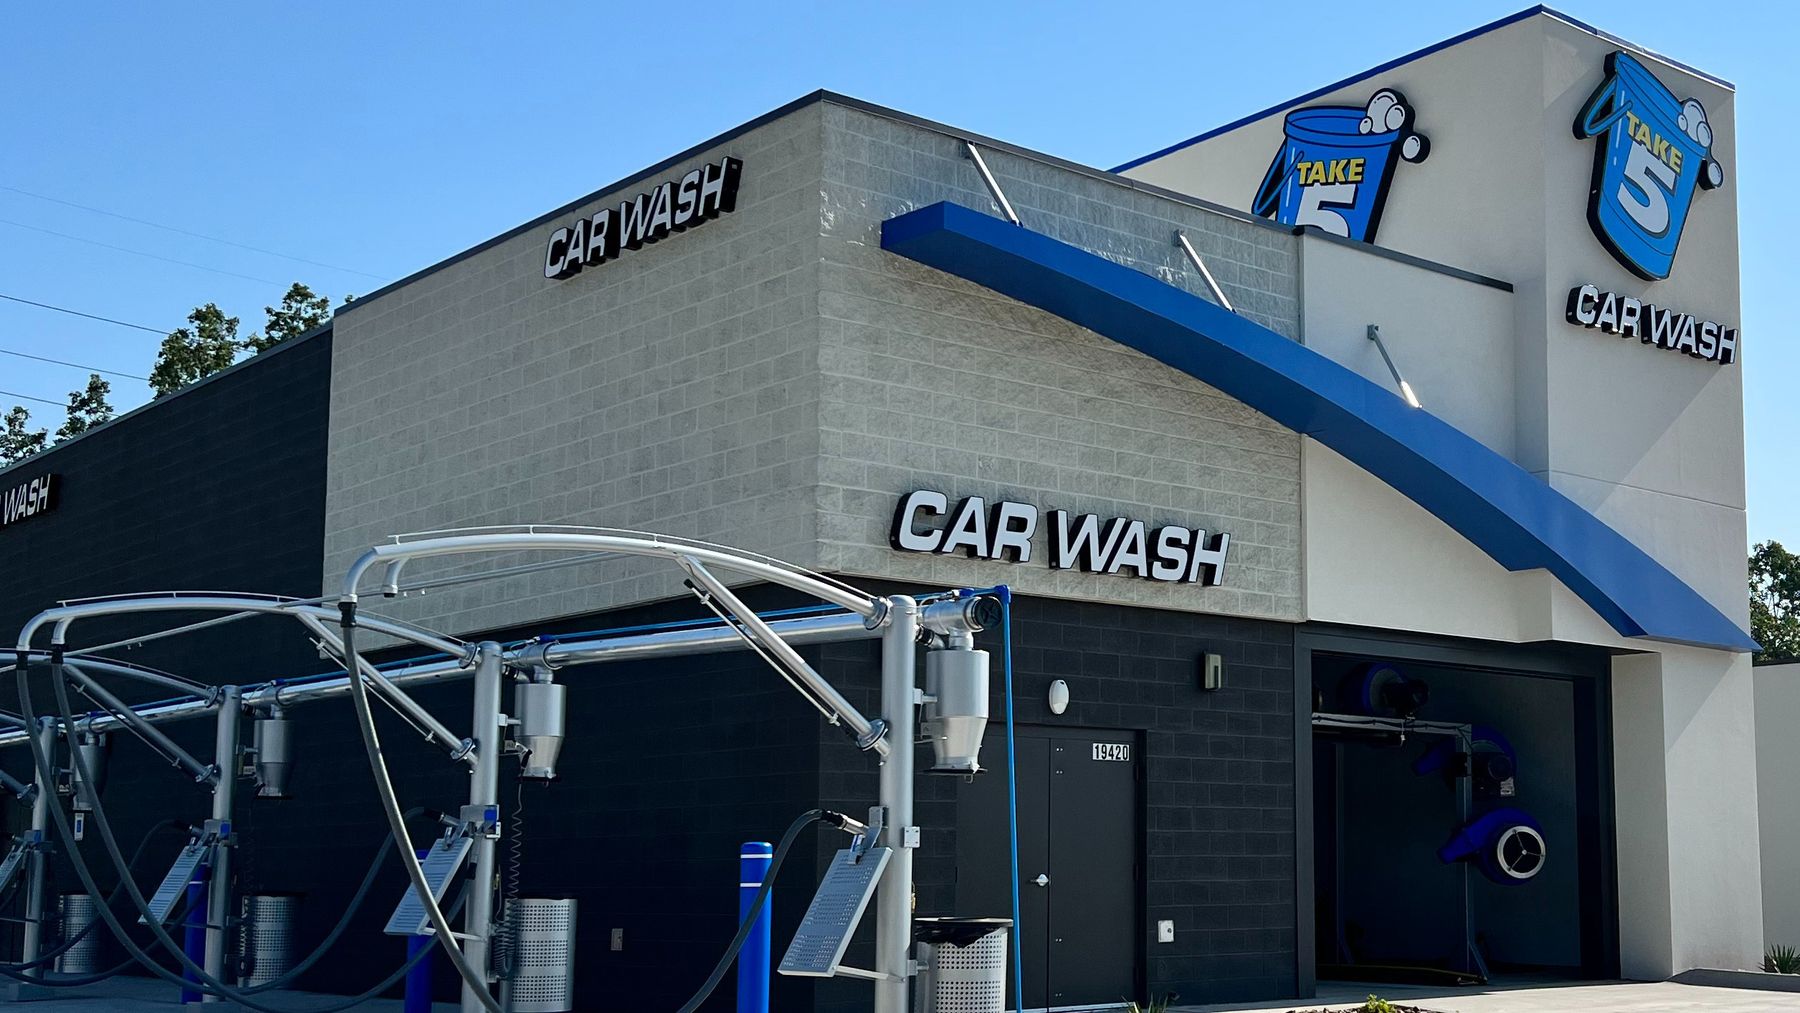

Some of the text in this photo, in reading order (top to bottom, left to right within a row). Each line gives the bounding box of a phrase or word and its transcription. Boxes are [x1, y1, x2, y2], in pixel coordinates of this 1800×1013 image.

[1297, 157, 1365, 186] TAKE
[1626, 110, 1683, 175] TAKE
[544, 156, 730, 279] CAR WASH
[1295, 183, 1360, 239] 5
[1617, 141, 1678, 235] 5
[1574, 284, 1739, 364] CAR WASH
[3, 473, 51, 525] WASH
[898, 489, 1231, 586] CAR WASH
[1094, 744, 1128, 760] 19420
